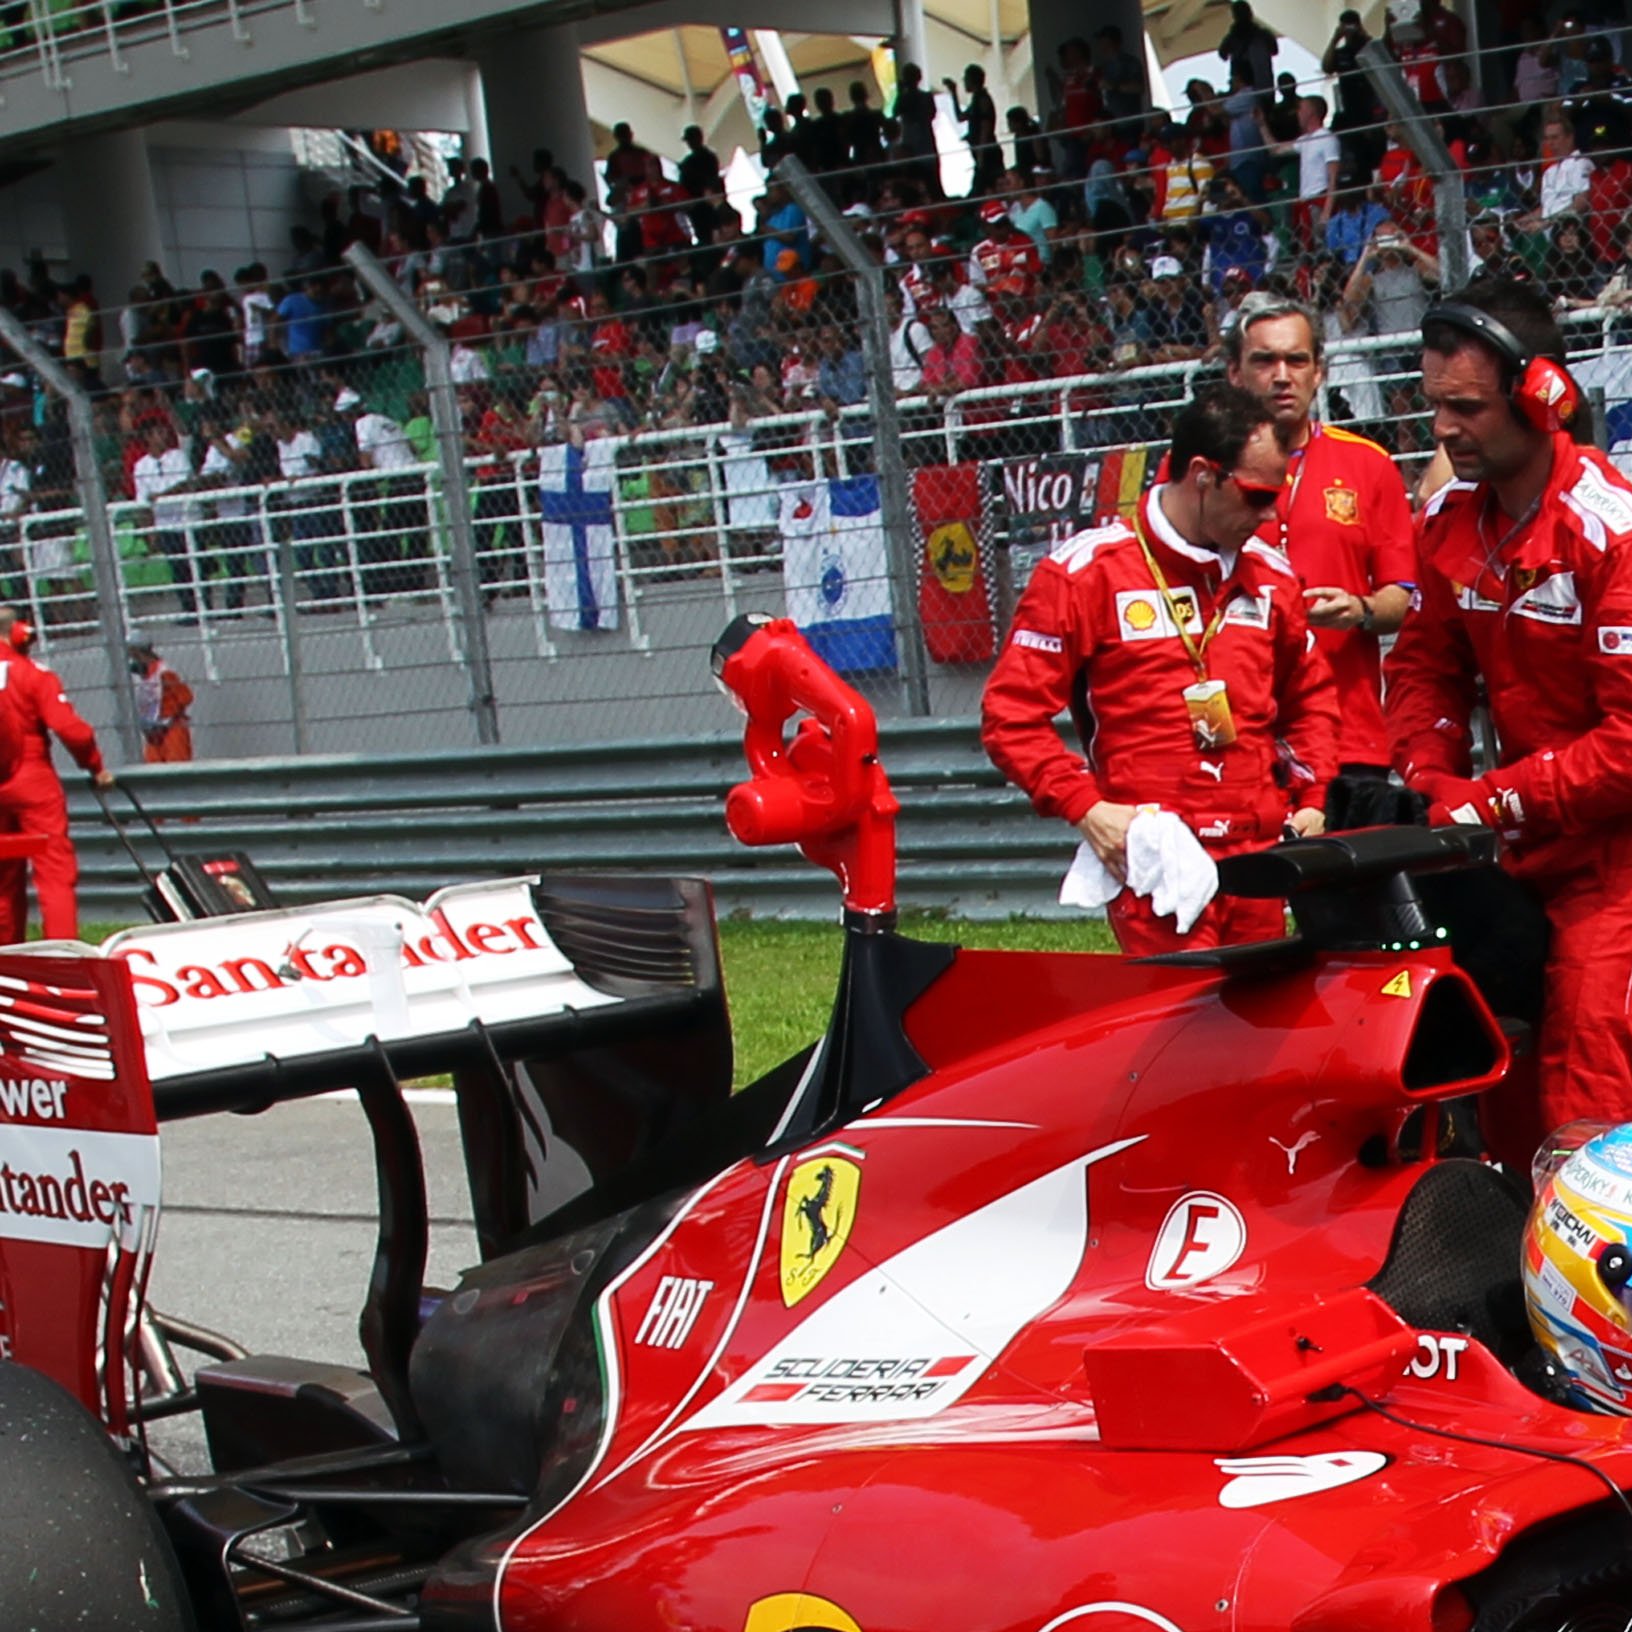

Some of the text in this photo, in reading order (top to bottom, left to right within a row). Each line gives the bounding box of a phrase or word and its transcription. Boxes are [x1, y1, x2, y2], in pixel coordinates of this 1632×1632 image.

[1003, 462, 1073, 515] Nico
[112, 906, 548, 1008] Santader
[0, 1148, 132, 1226] tander
[634, 1274, 714, 1350] FIAT
[764, 1356, 927, 1379] SCUDERIA
[1402, 1334, 1467, 1381] OT
[794, 1379, 943, 1403] FERRARI
